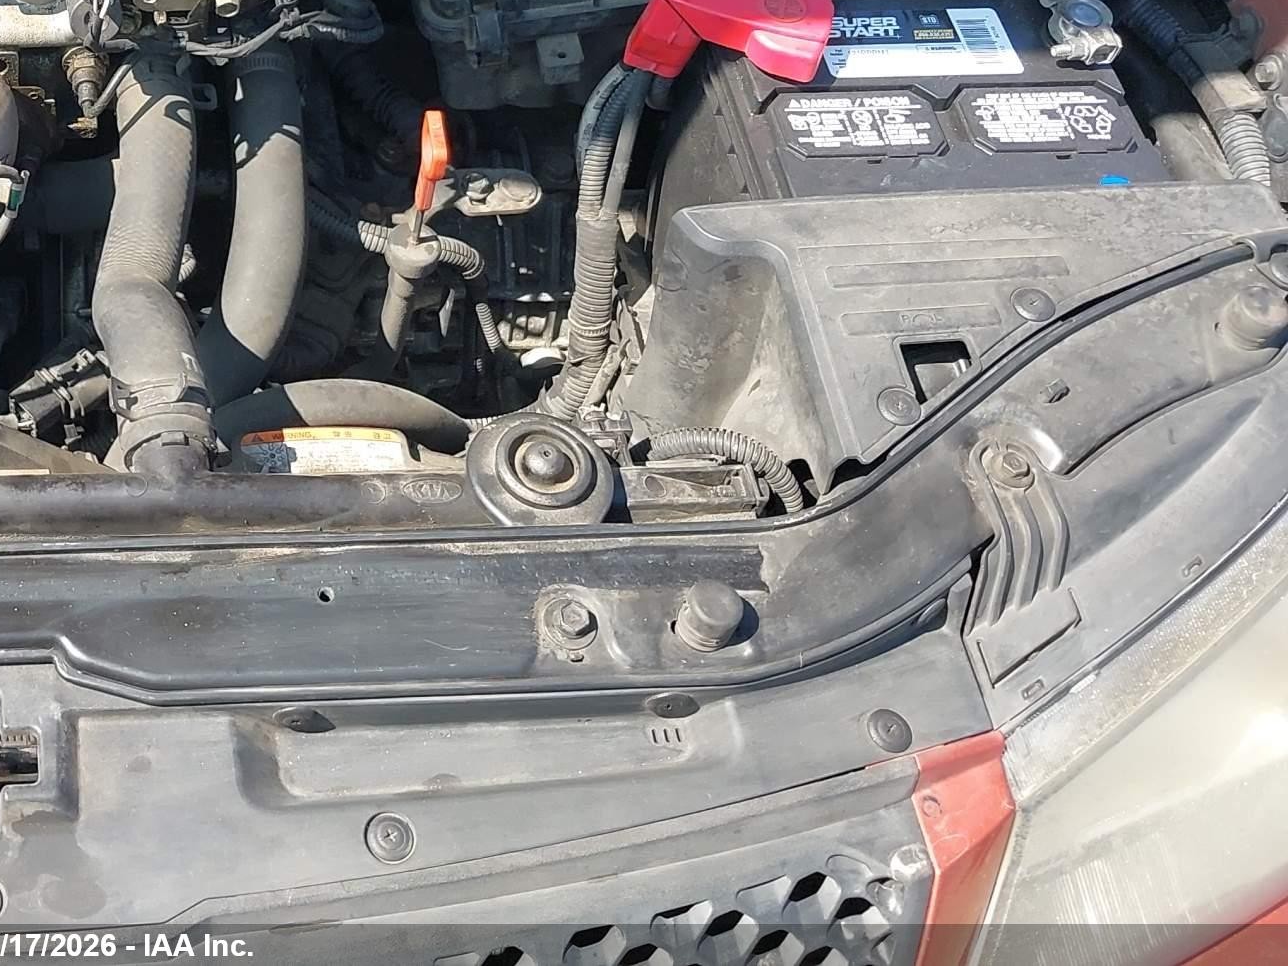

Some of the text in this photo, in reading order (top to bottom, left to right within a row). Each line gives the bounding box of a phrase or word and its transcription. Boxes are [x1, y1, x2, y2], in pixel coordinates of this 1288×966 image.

[831, 16, 898, 28] SUPER
[827, 26, 901, 39] START
[799, 98, 853, 109] DANGER
[863, 96, 912, 108] POISON
